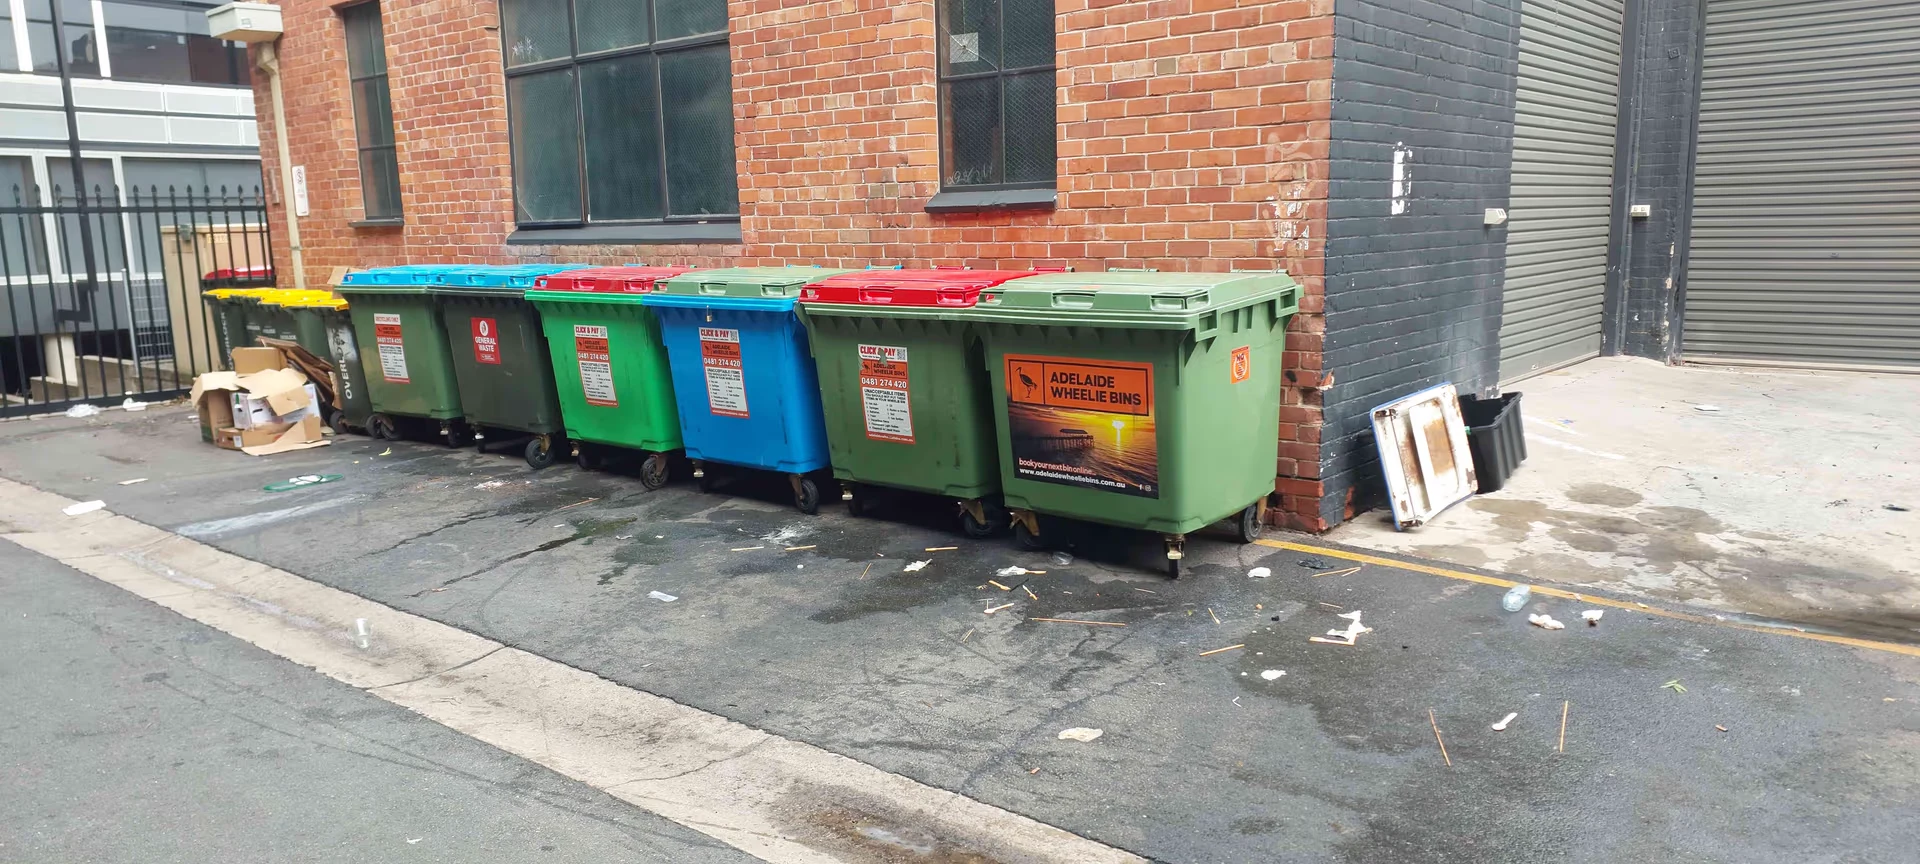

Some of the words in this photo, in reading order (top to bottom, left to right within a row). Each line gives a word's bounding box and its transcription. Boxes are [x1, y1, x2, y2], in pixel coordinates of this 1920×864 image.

[860, 346, 876, 355] CLICK
[884, 348, 896, 356] PAY
[862, 377, 878, 385] 0481
[894, 380, 907, 388] 420
[1050, 372, 1115, 388] ADELAIDE
[1051, 386, 1107, 403] WHEELIE
[1110, 391, 1142, 406] BINS
[1020, 468, 1126, 488] www.adelaidewheeliebins.com.au
